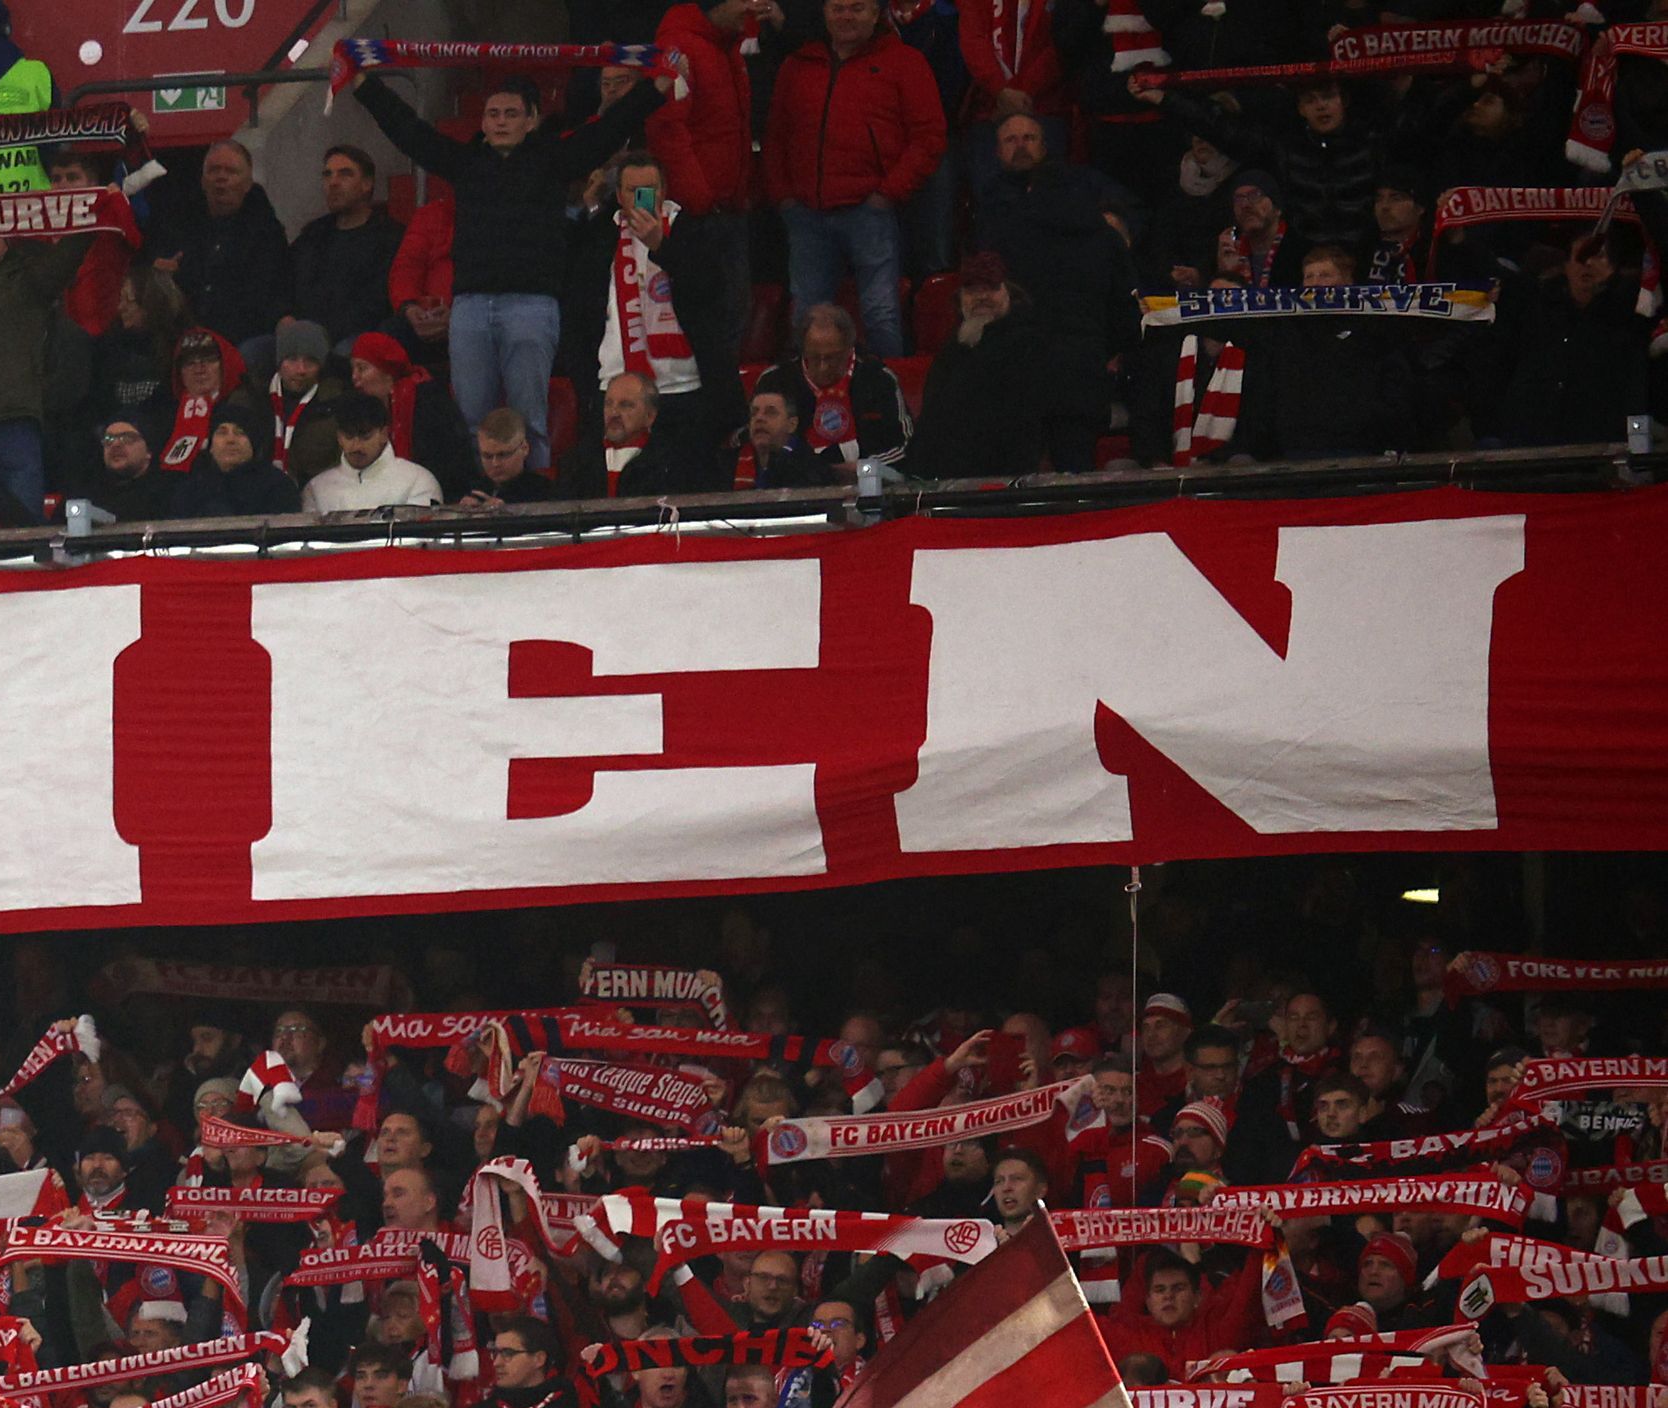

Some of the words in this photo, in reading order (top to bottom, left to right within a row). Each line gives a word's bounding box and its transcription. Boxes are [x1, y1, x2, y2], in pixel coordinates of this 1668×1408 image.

[1333, 37, 1360, 63] FC
[1365, 29, 1460, 57] BAYERN
[1469, 23, 1583, 53] MÜNCHEN
[1469, 188, 1559, 213] BAYERN
[565, 1083, 605, 1104] des
[591, 1061, 655, 1095] League
[651, 1071, 709, 1110] Sieger
[830, 1122, 858, 1147] FC
[867, 1115, 957, 1146] BAYERN
[662, 1222, 697, 1252] FC
[708, 1214, 838, 1243] BAYERN
